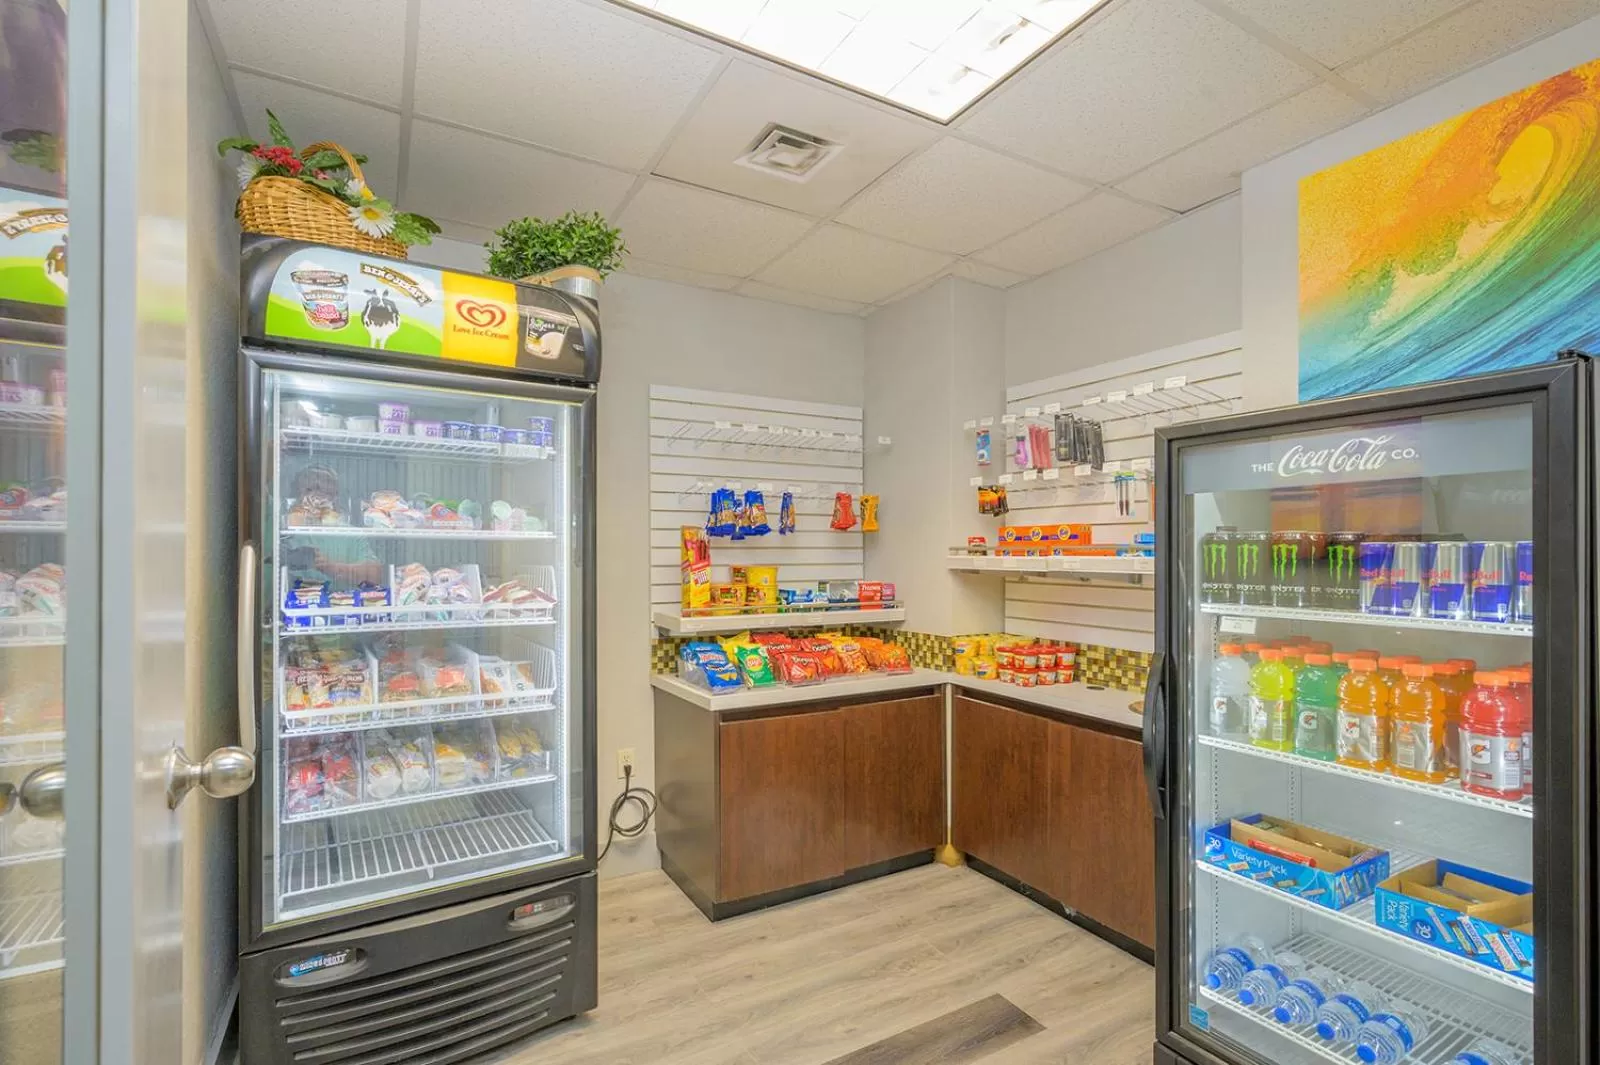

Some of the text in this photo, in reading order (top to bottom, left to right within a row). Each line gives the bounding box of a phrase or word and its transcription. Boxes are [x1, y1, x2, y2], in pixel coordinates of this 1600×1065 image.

[452, 323, 510, 340] Love Ice Cream
[1251, 462, 1275, 473] THE
[1391, 447, 1420, 460] CO.
[1209, 838, 1222, 849] 30
[1231, 846, 1288, 876] Variety Pack
[1387, 899, 1398, 921] Pack
[1399, 900, 1409, 932] Variety
[1416, 921, 1432, 939] 30
